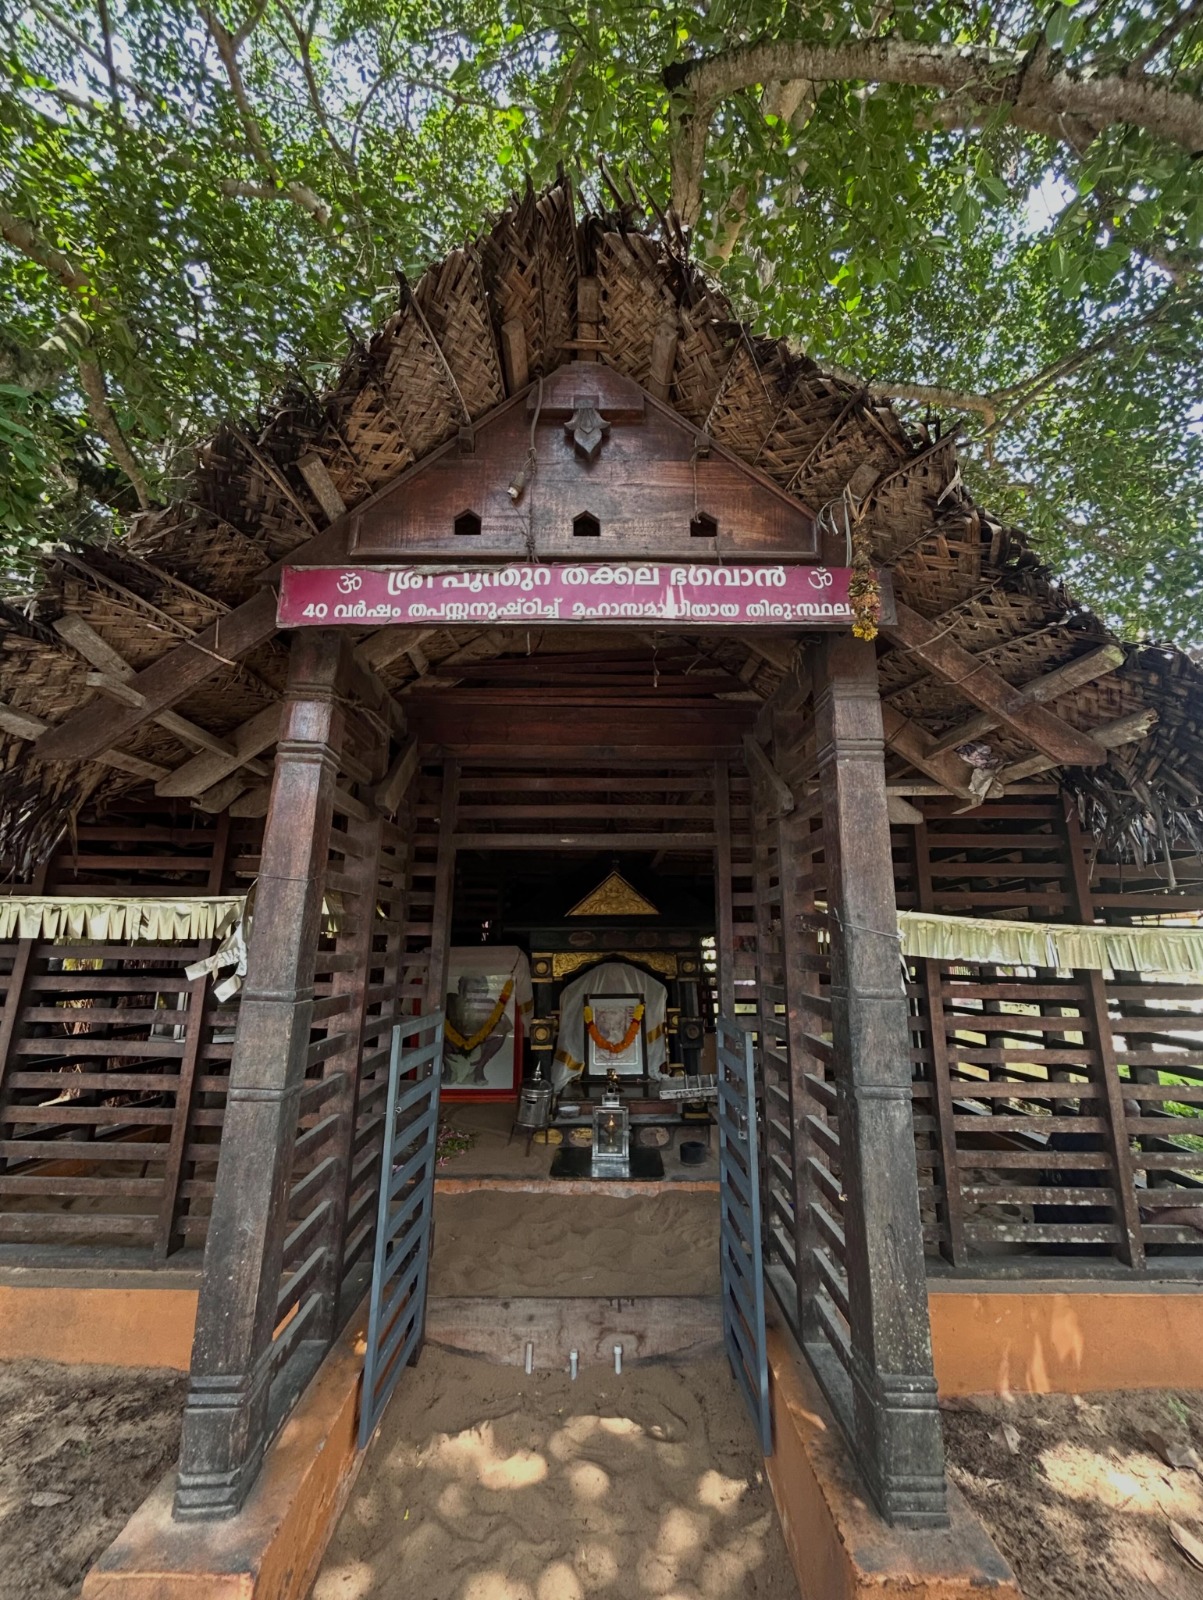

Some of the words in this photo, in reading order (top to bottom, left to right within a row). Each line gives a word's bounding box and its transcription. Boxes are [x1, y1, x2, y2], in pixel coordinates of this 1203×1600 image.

[442, 567, 551, 593] പൂന്തുറ
[561, 566, 660, 585] തക്കല
[670, 565, 786, 587] ഭഗവാൻ
[302, 603, 328, 618] 40
[333, 600, 402, 618] വർഷം
